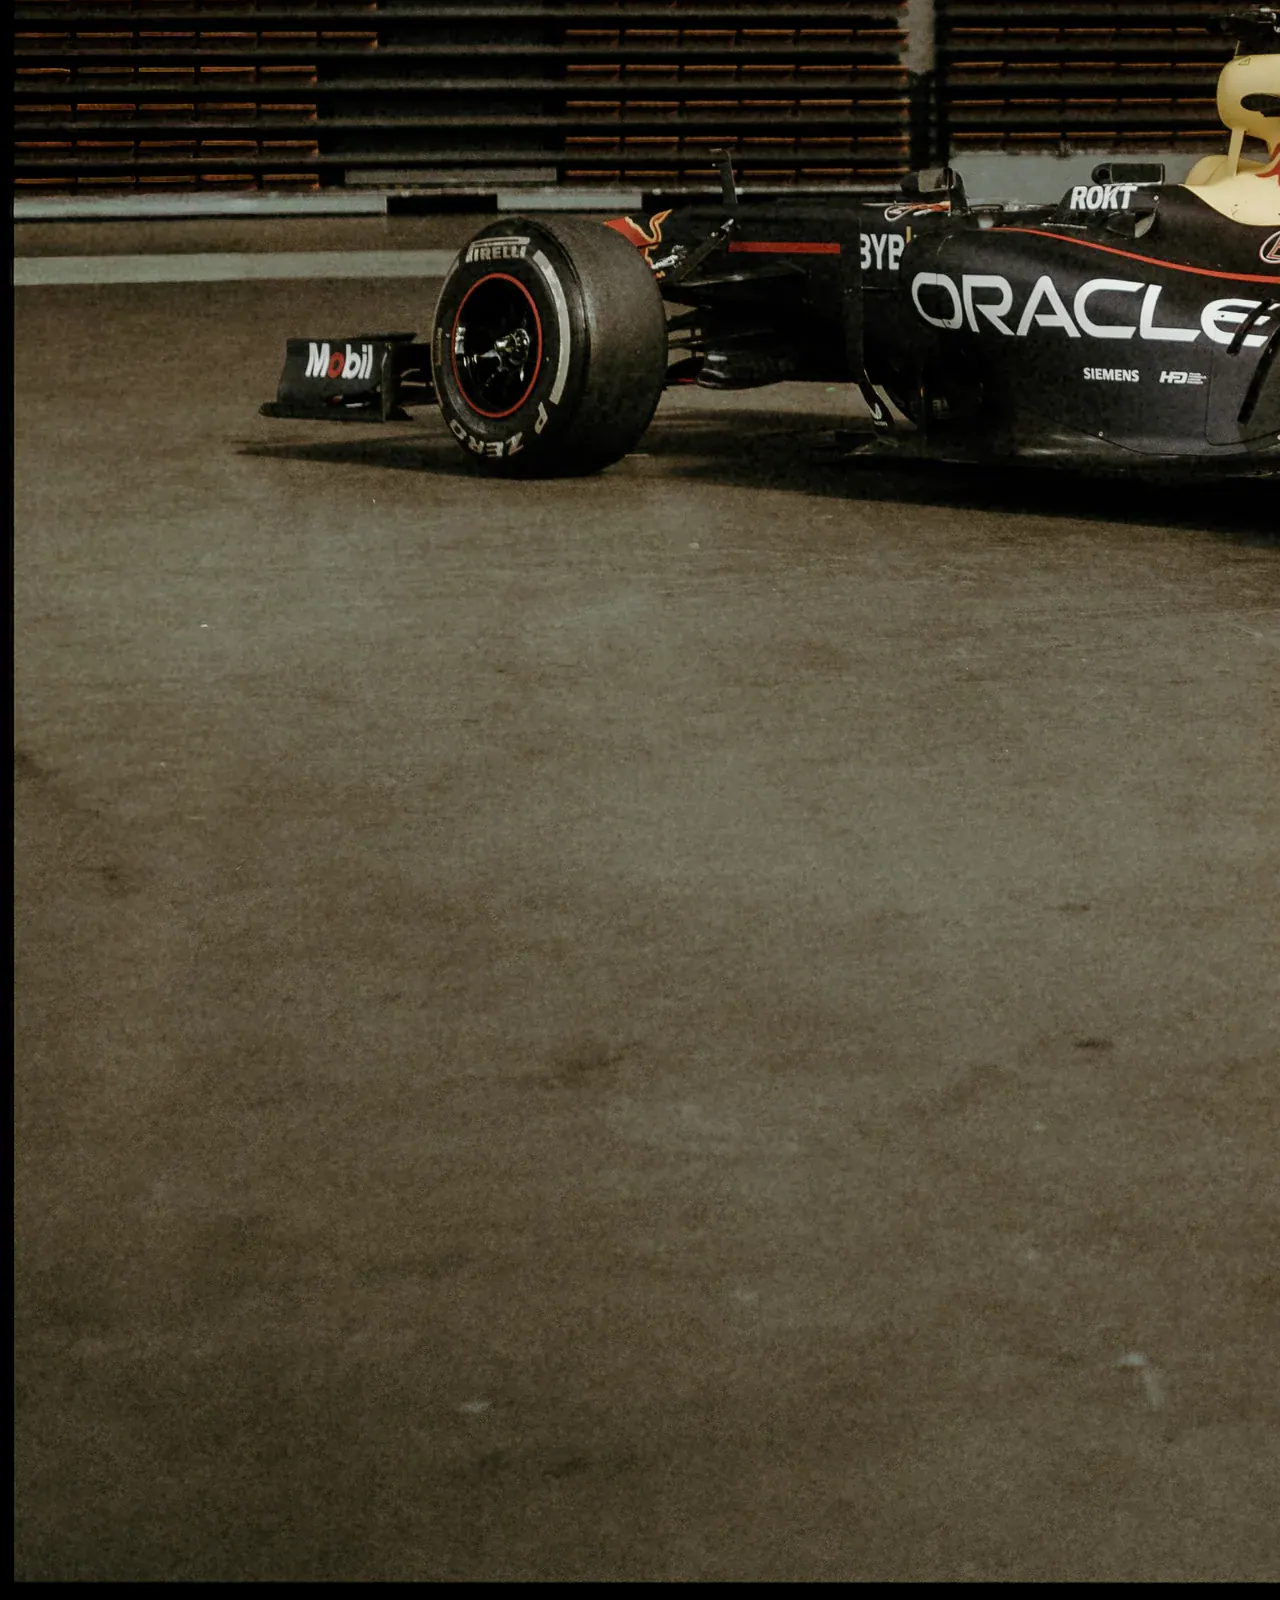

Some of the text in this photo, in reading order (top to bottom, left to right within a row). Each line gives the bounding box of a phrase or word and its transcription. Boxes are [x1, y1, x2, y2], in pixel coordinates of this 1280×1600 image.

[1069, 185, 1138, 210] ROKT
[466, 236, 530, 263] PIRELLI
[911, 272, 1280, 348] ORACLE
[305, 342, 374, 381] Mobil
[1083, 367, 1140, 383] SIEMENS
[449, 401, 549, 458] P ZERO
